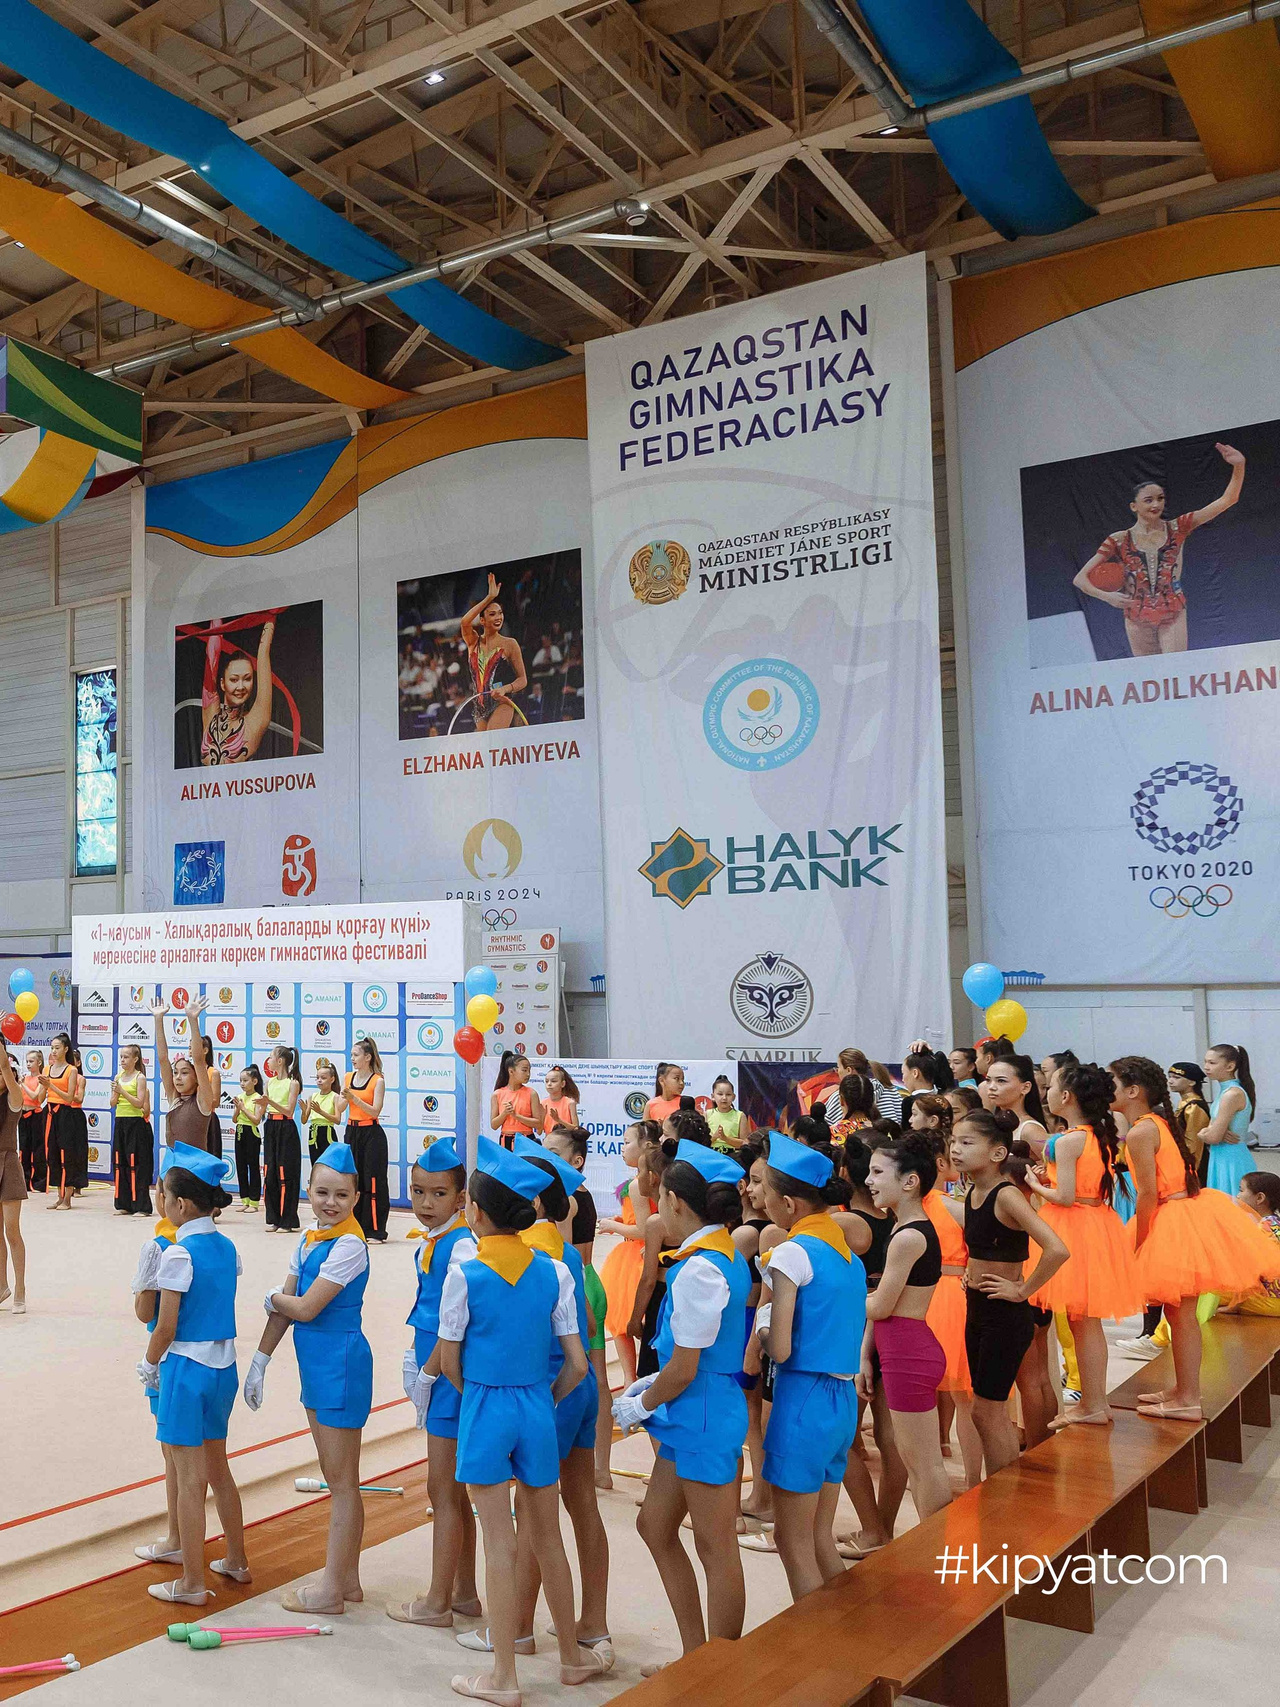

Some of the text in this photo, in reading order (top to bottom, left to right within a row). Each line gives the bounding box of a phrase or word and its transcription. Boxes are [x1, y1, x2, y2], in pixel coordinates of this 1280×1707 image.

[630, 304, 869, 391] QAZAQSTAN
[629, 347, 875, 430] GIMNASTIKA
[619, 382, 891, 472] FEDERACIASY
[698, 529, 780, 554] QAZAQSTAN
[699, 523, 892, 570] MÁDENIET JÁNE SPORT
[699, 541, 893, 594] MINISTRLIGI
[1029, 666, 1280, 715] ALINA ADILKHAN
[709, 664, 813, 765] NATIONAL OLYMPIC COMMITTEE OF THE REPUBLIC OF KAZAKHSTAN
[403, 740, 581, 776] ELZHANA TANIYEVA
[180, 772, 316, 801] ALIYA YUSSUPOVA
[726, 823, 904, 865] HALYK
[727, 857, 889, 895] BANK
[1128, 860, 1253, 881] TOKYO 2020
[497, 888, 540, 900] 2024
[164, 919, 253, 943] Халықаралық
[257, 917, 331, 941] балаларды
[336, 917, 386, 940] қорғау
[391, 912, 431, 939] күні»
[490, 935, 522, 943] RHYTHMIC
[93, 938, 427, 969] мерекесіне арналған көркем гимнастика фестивалі
[487, 944, 526, 952] GYMNASTICS
[422, 1069, 452, 1077] AMANAT
